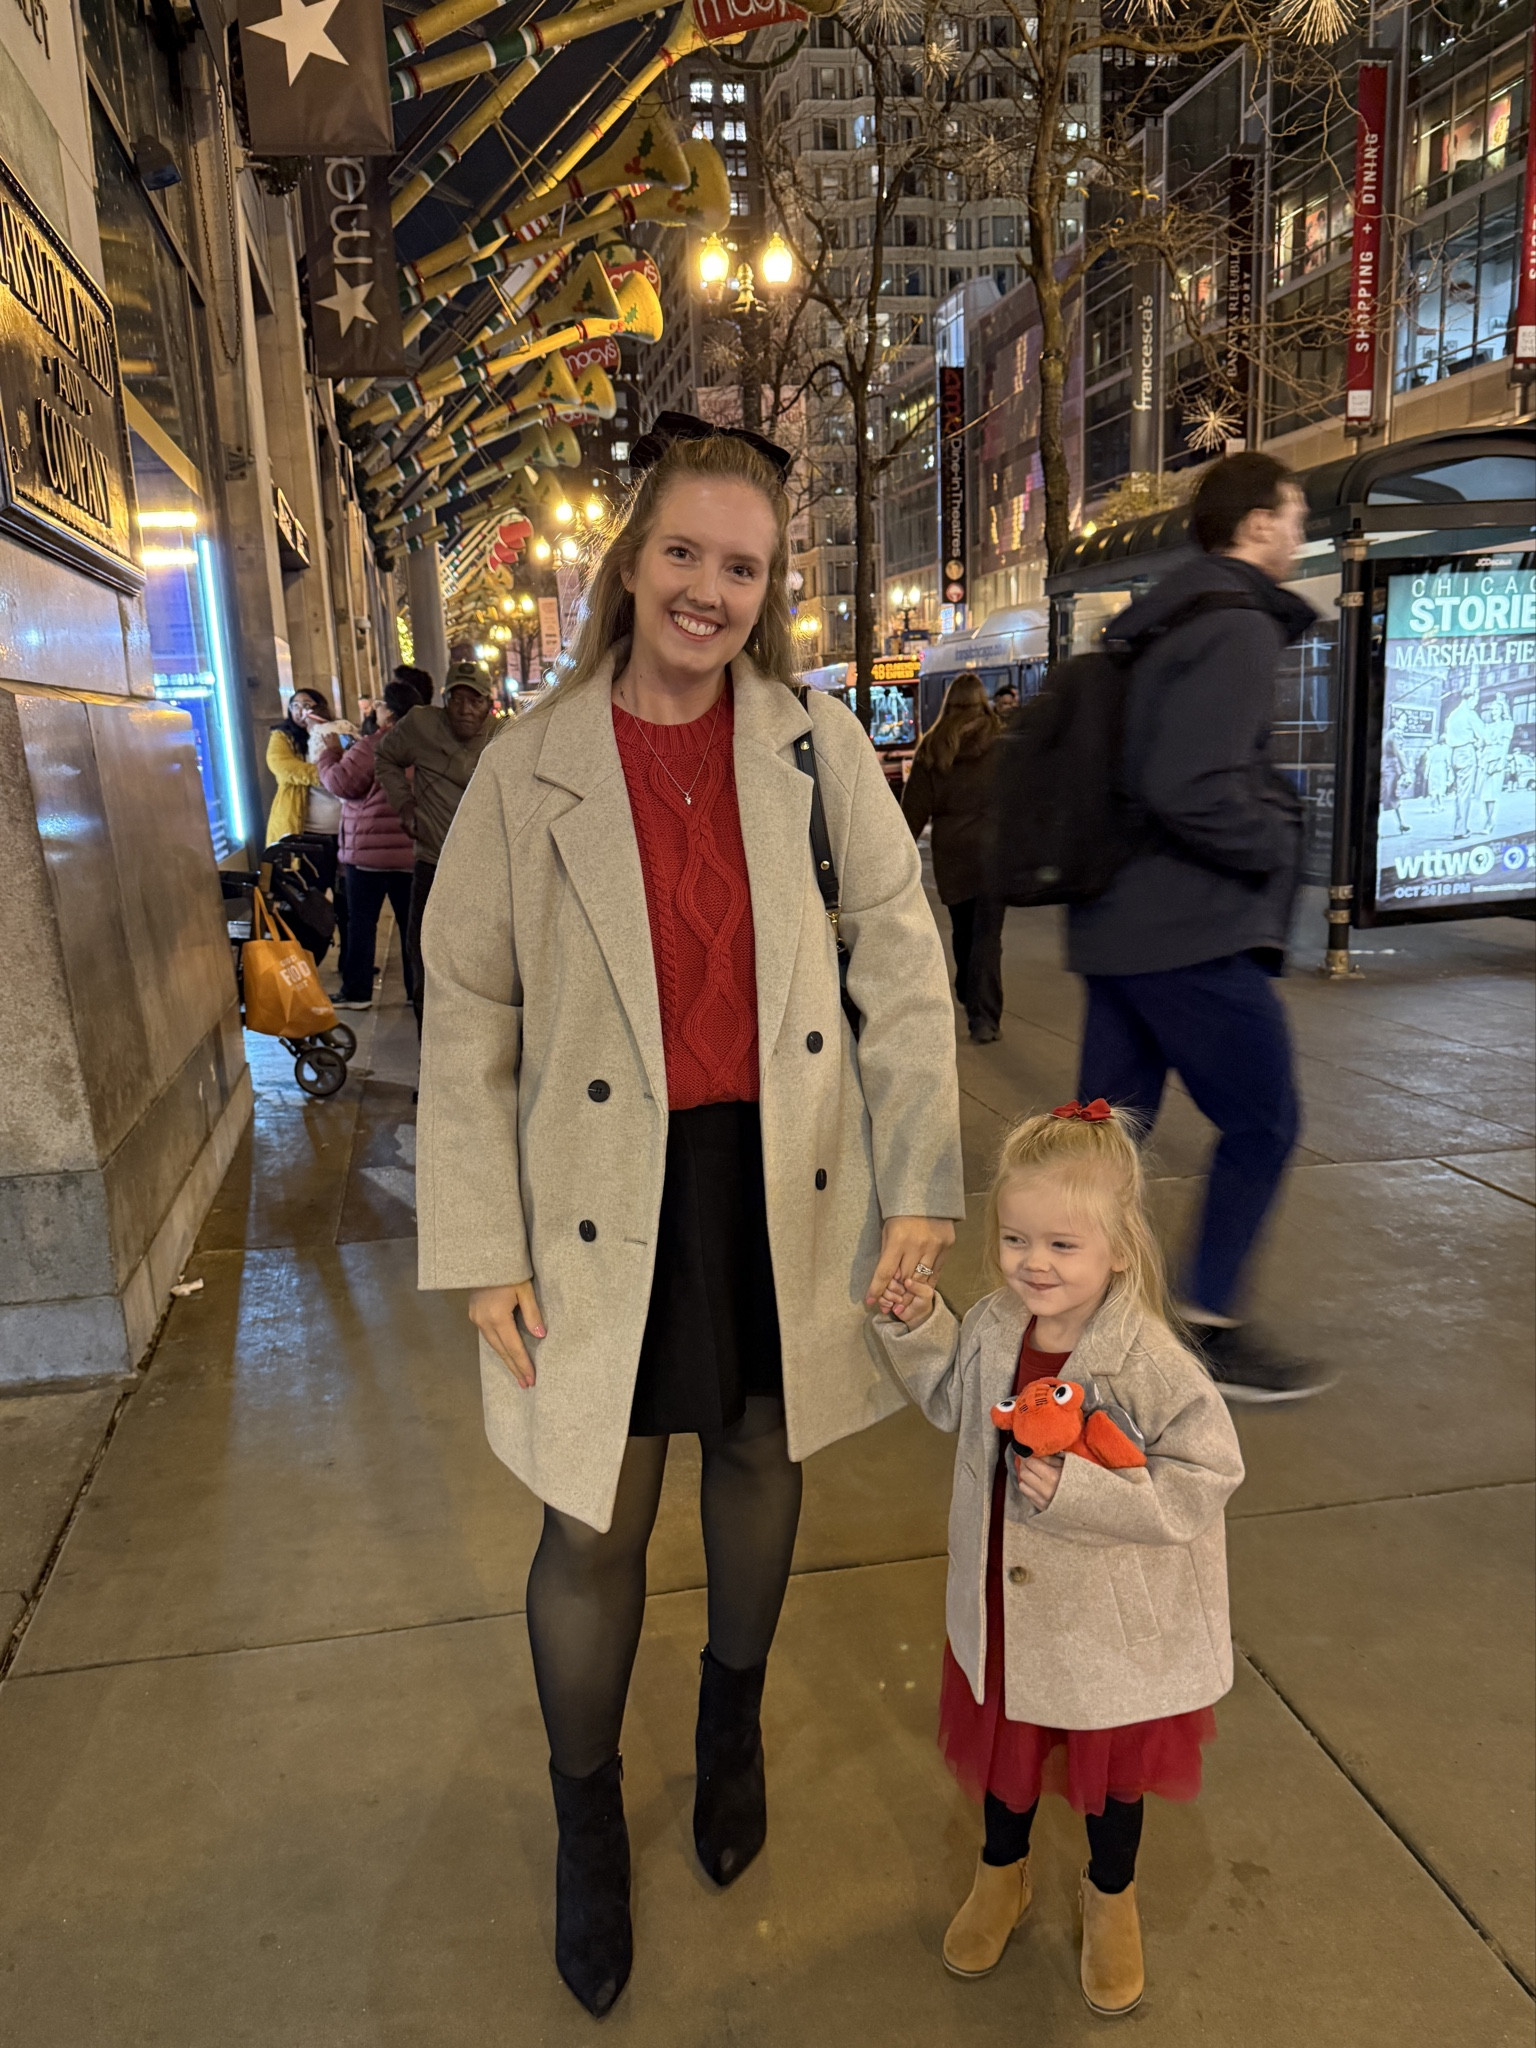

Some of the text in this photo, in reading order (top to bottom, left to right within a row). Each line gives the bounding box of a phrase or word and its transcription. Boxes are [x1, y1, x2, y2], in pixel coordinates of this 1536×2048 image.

[1362, 132, 1379, 204] DINING
[0, 200, 80, 360] ARSHALL
[1356, 251, 1374, 352] SHOPPING
[53, 356, 86, 417] AND
[1132, 294, 1154, 411] francesca's
[38, 398, 113, 528] COMPANY
[1395, 642, 1503, 669] MARSHALL
[1394, 849, 1470, 881] wttw
[1394, 885, 1421, 899] OCT
[1452, 881, 1471, 895] PM
